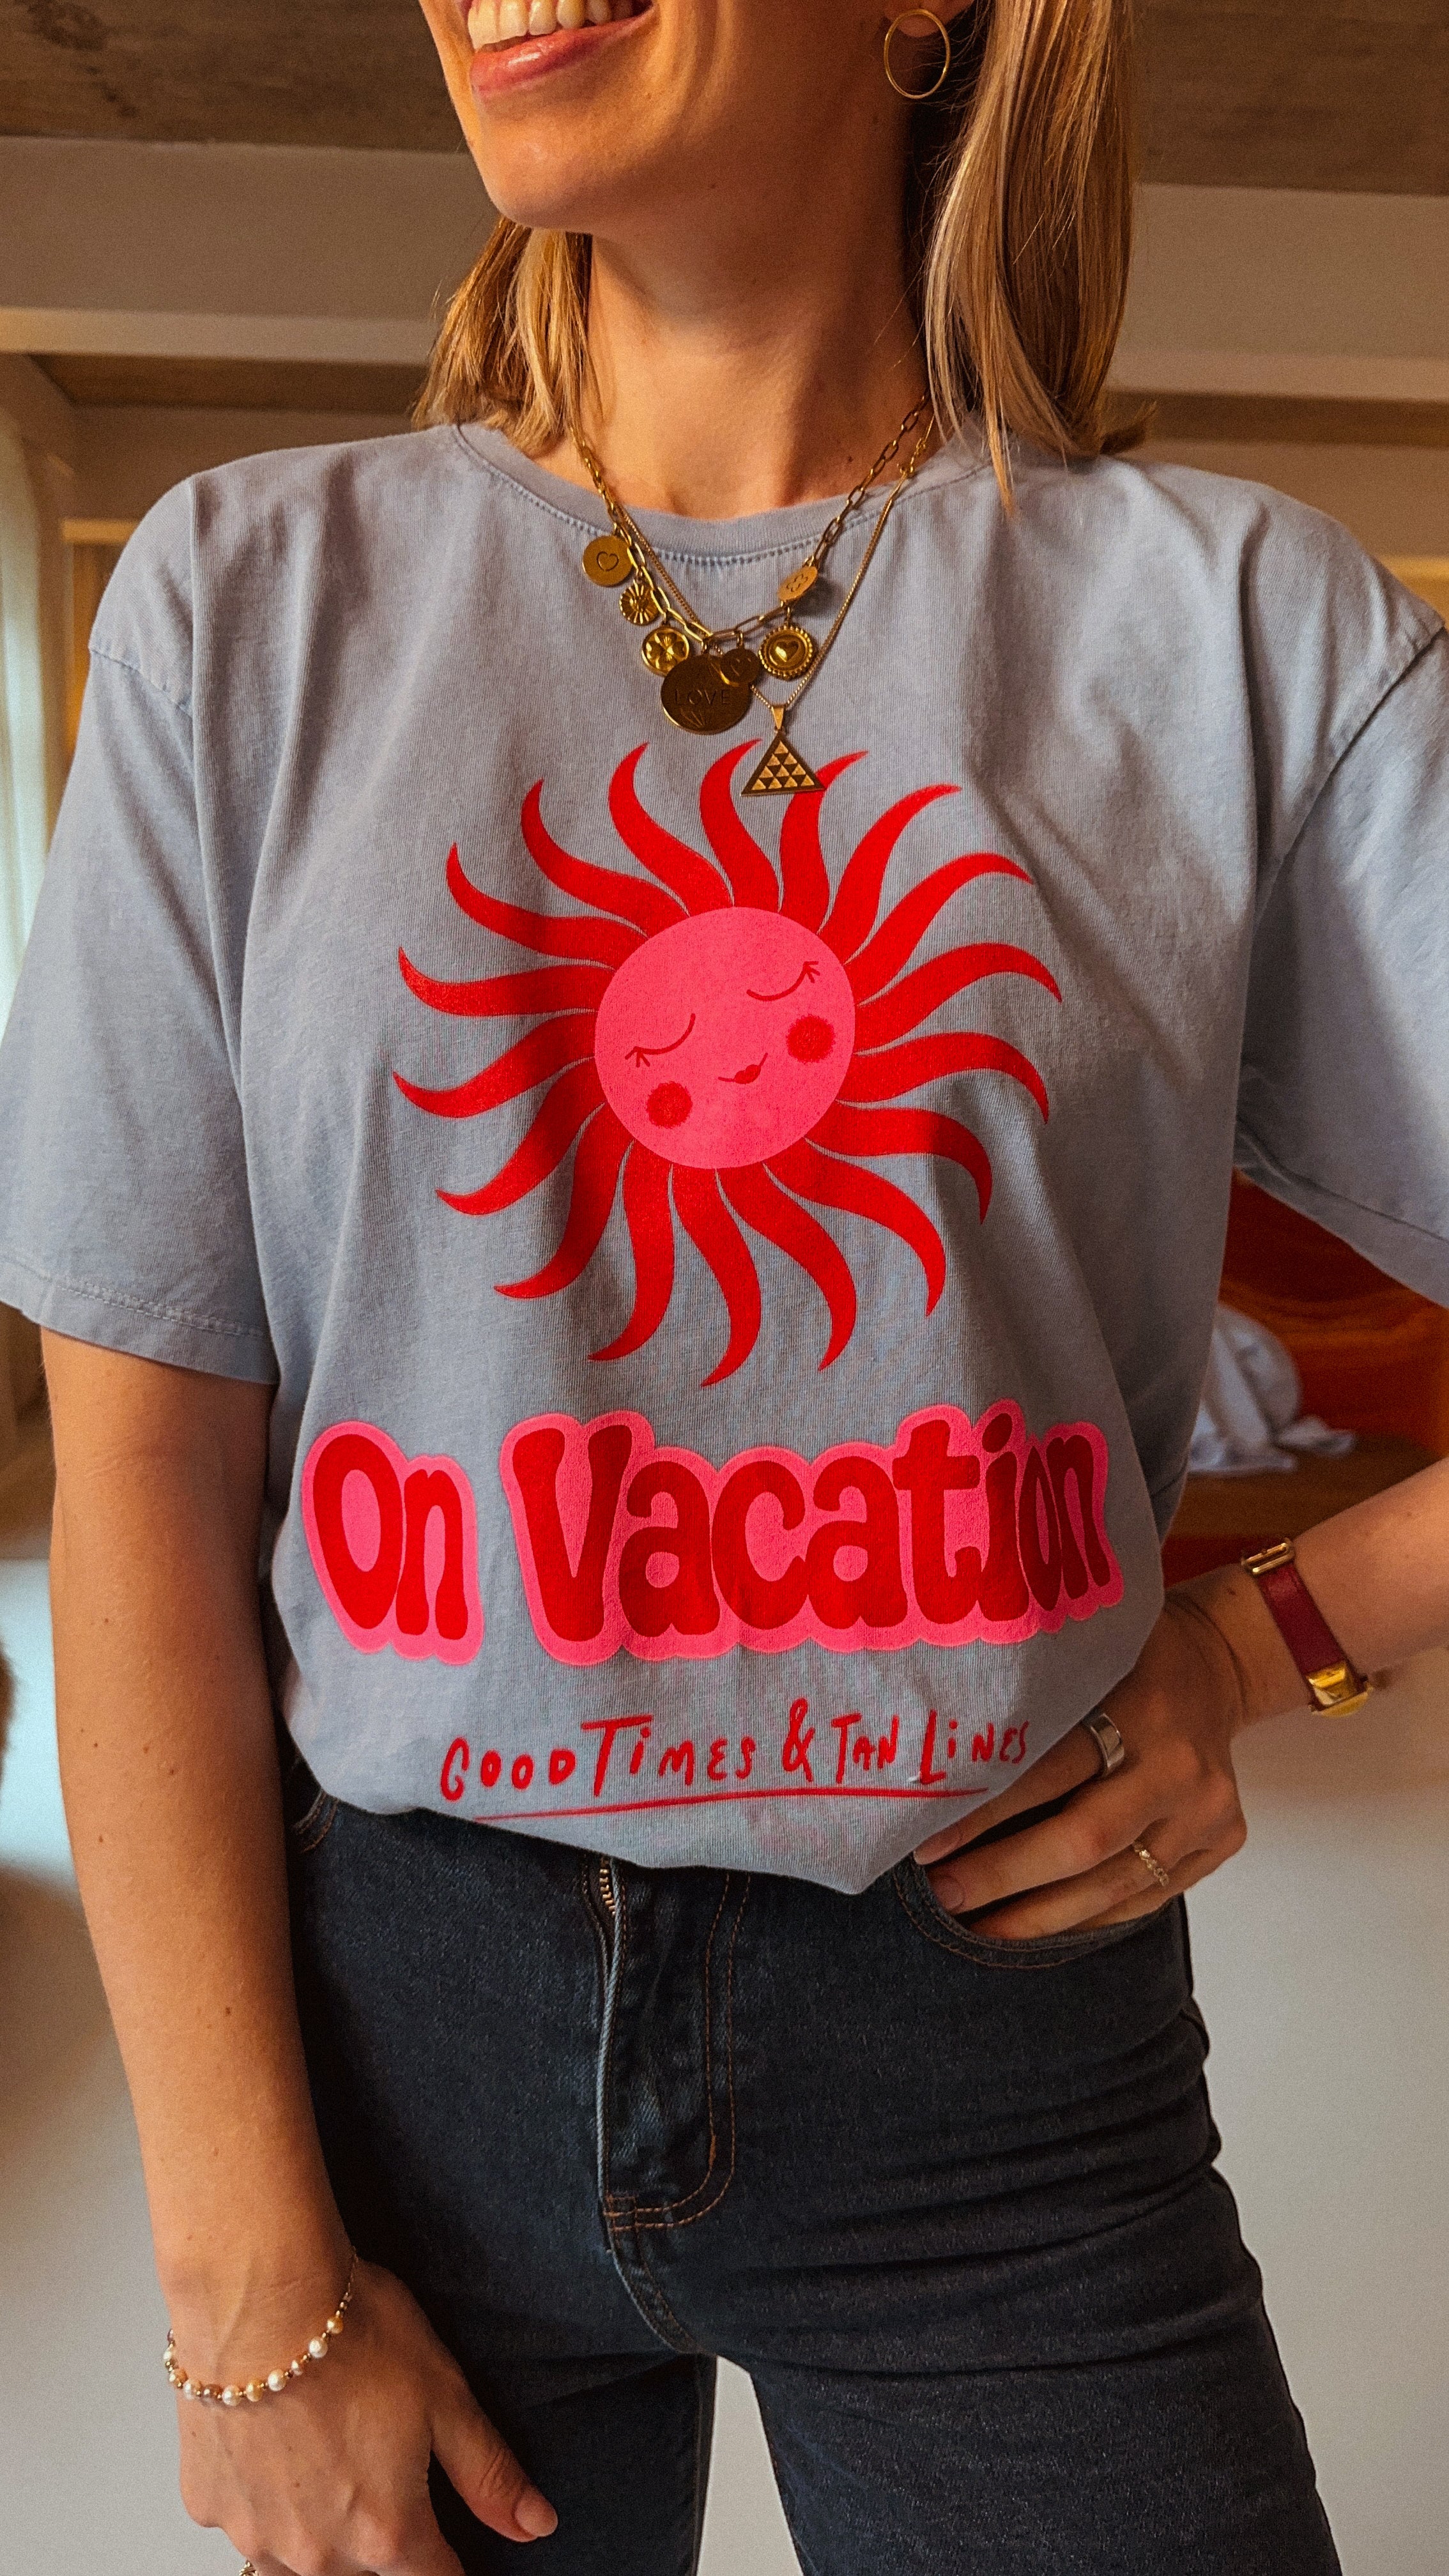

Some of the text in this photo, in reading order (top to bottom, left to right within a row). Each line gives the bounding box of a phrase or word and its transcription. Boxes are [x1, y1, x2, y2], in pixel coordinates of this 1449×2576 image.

[674, 688, 732, 705] LOVE
[312, 1411, 1114, 1643] On Vacation
[782, 1696, 816, 1783] &
[831, 1712, 900, 1784] TAN
